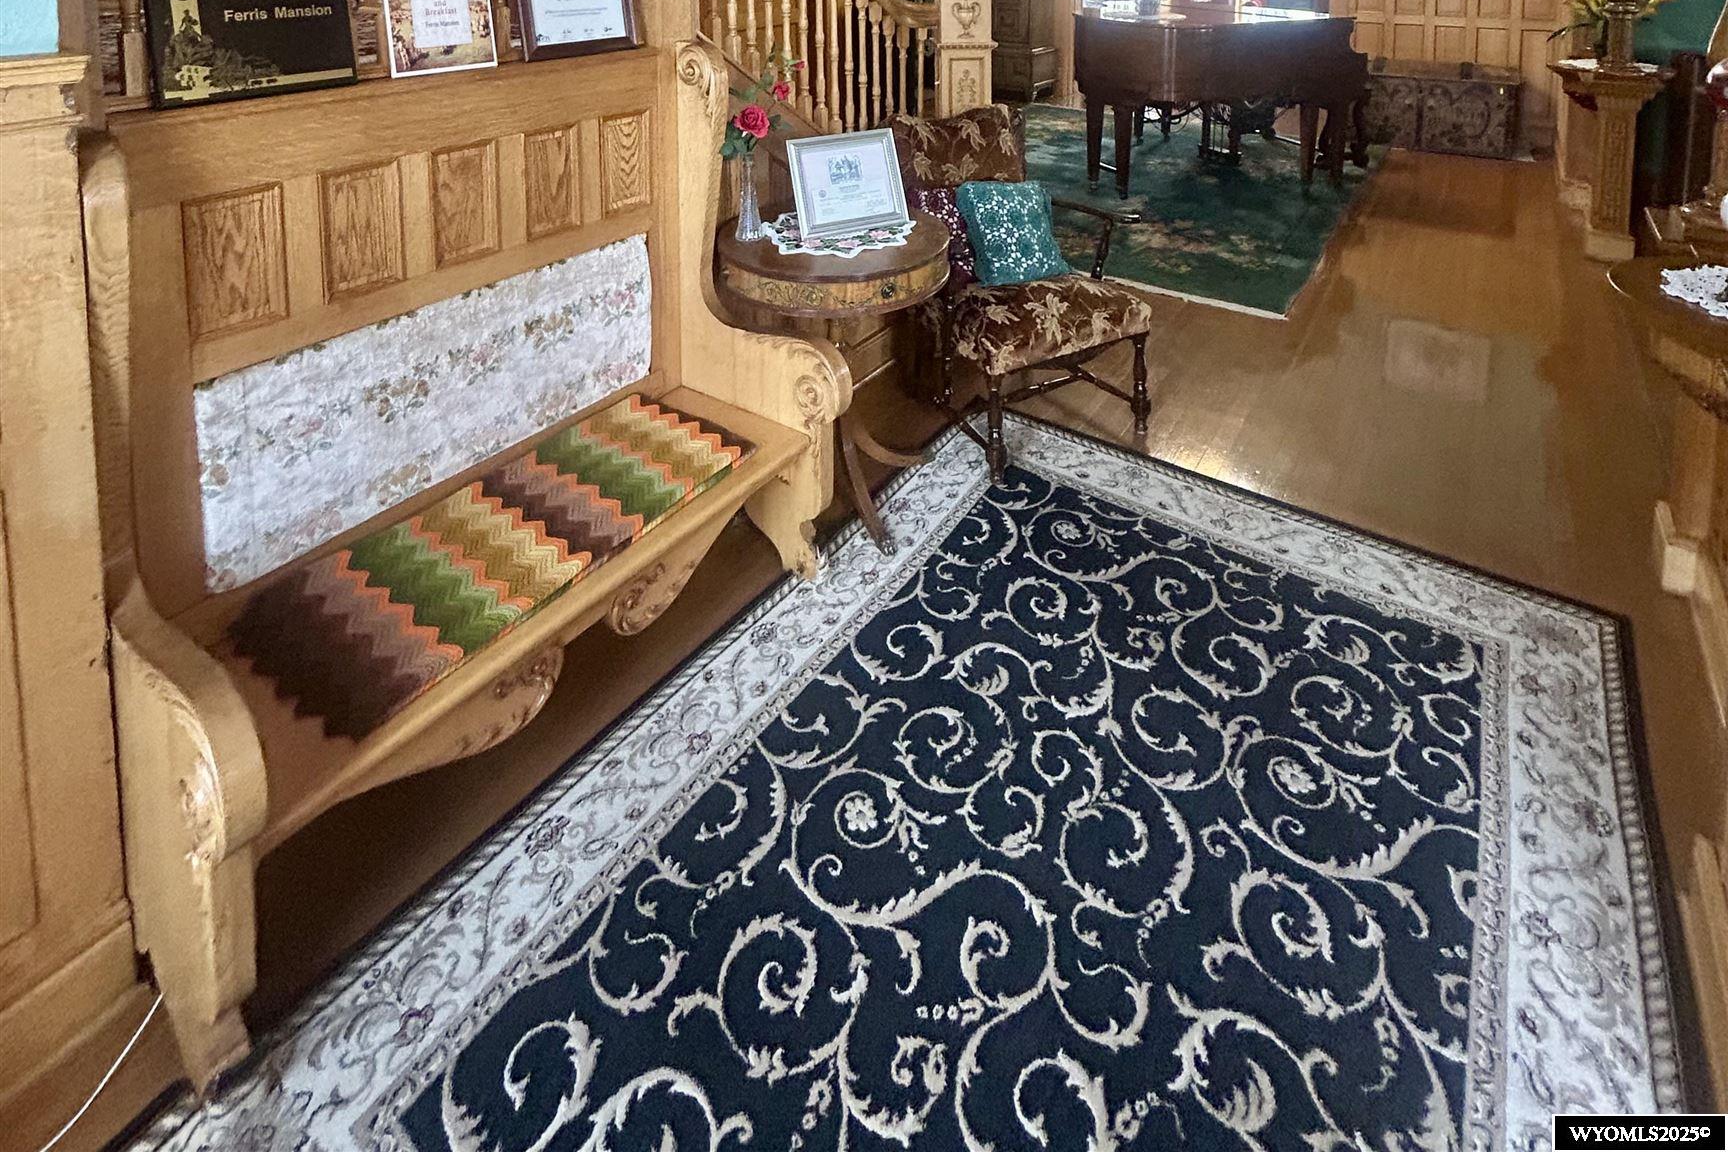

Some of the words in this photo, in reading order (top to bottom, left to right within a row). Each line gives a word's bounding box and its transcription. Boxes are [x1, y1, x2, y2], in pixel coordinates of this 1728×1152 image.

[223, 8, 268, 22] Ferris
[274, 4, 333, 19] Mansion
[425, 7, 457, 16] Breakfast
